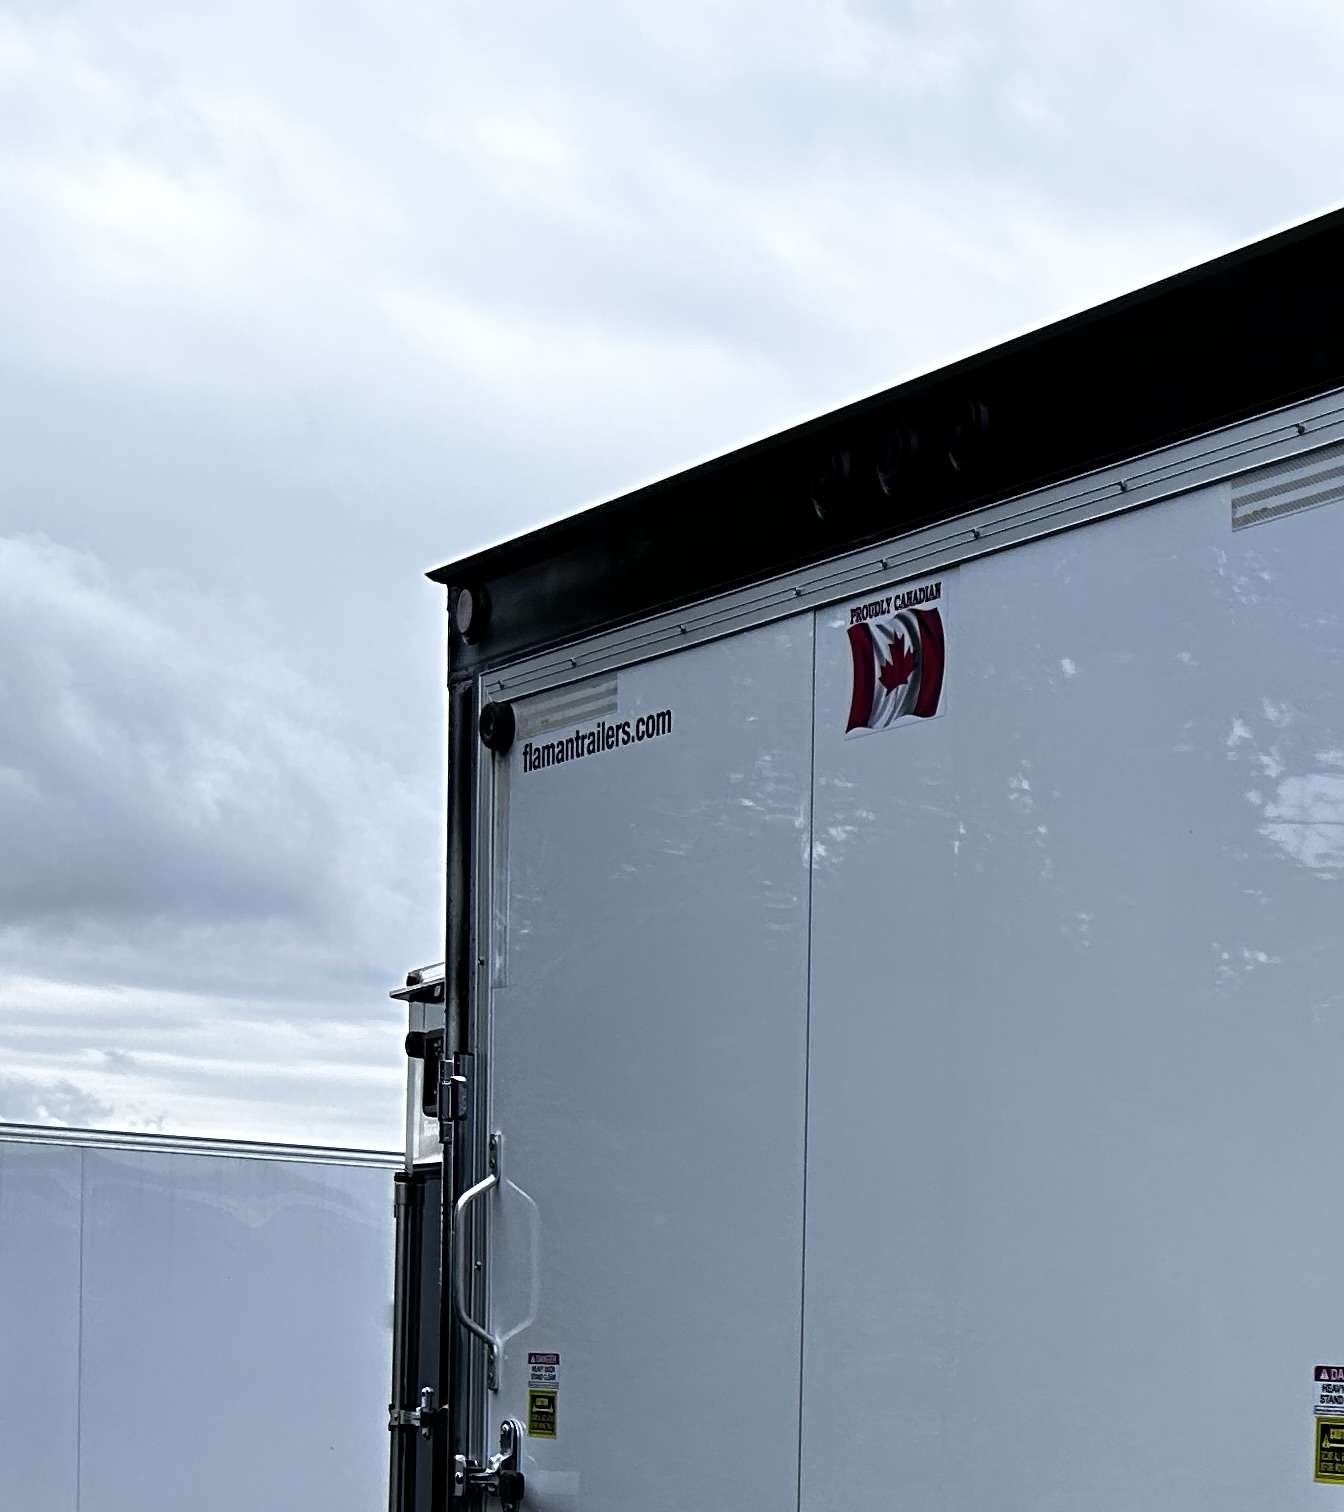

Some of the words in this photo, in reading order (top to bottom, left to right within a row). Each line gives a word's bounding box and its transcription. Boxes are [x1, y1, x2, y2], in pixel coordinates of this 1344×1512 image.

[850, 596, 892, 624] PROUDLY
[894, 582, 942, 610] CANADIAN
[523, 709, 673, 772] flamantrailers.com
[1320, 1395, 1344, 1405] STAND
